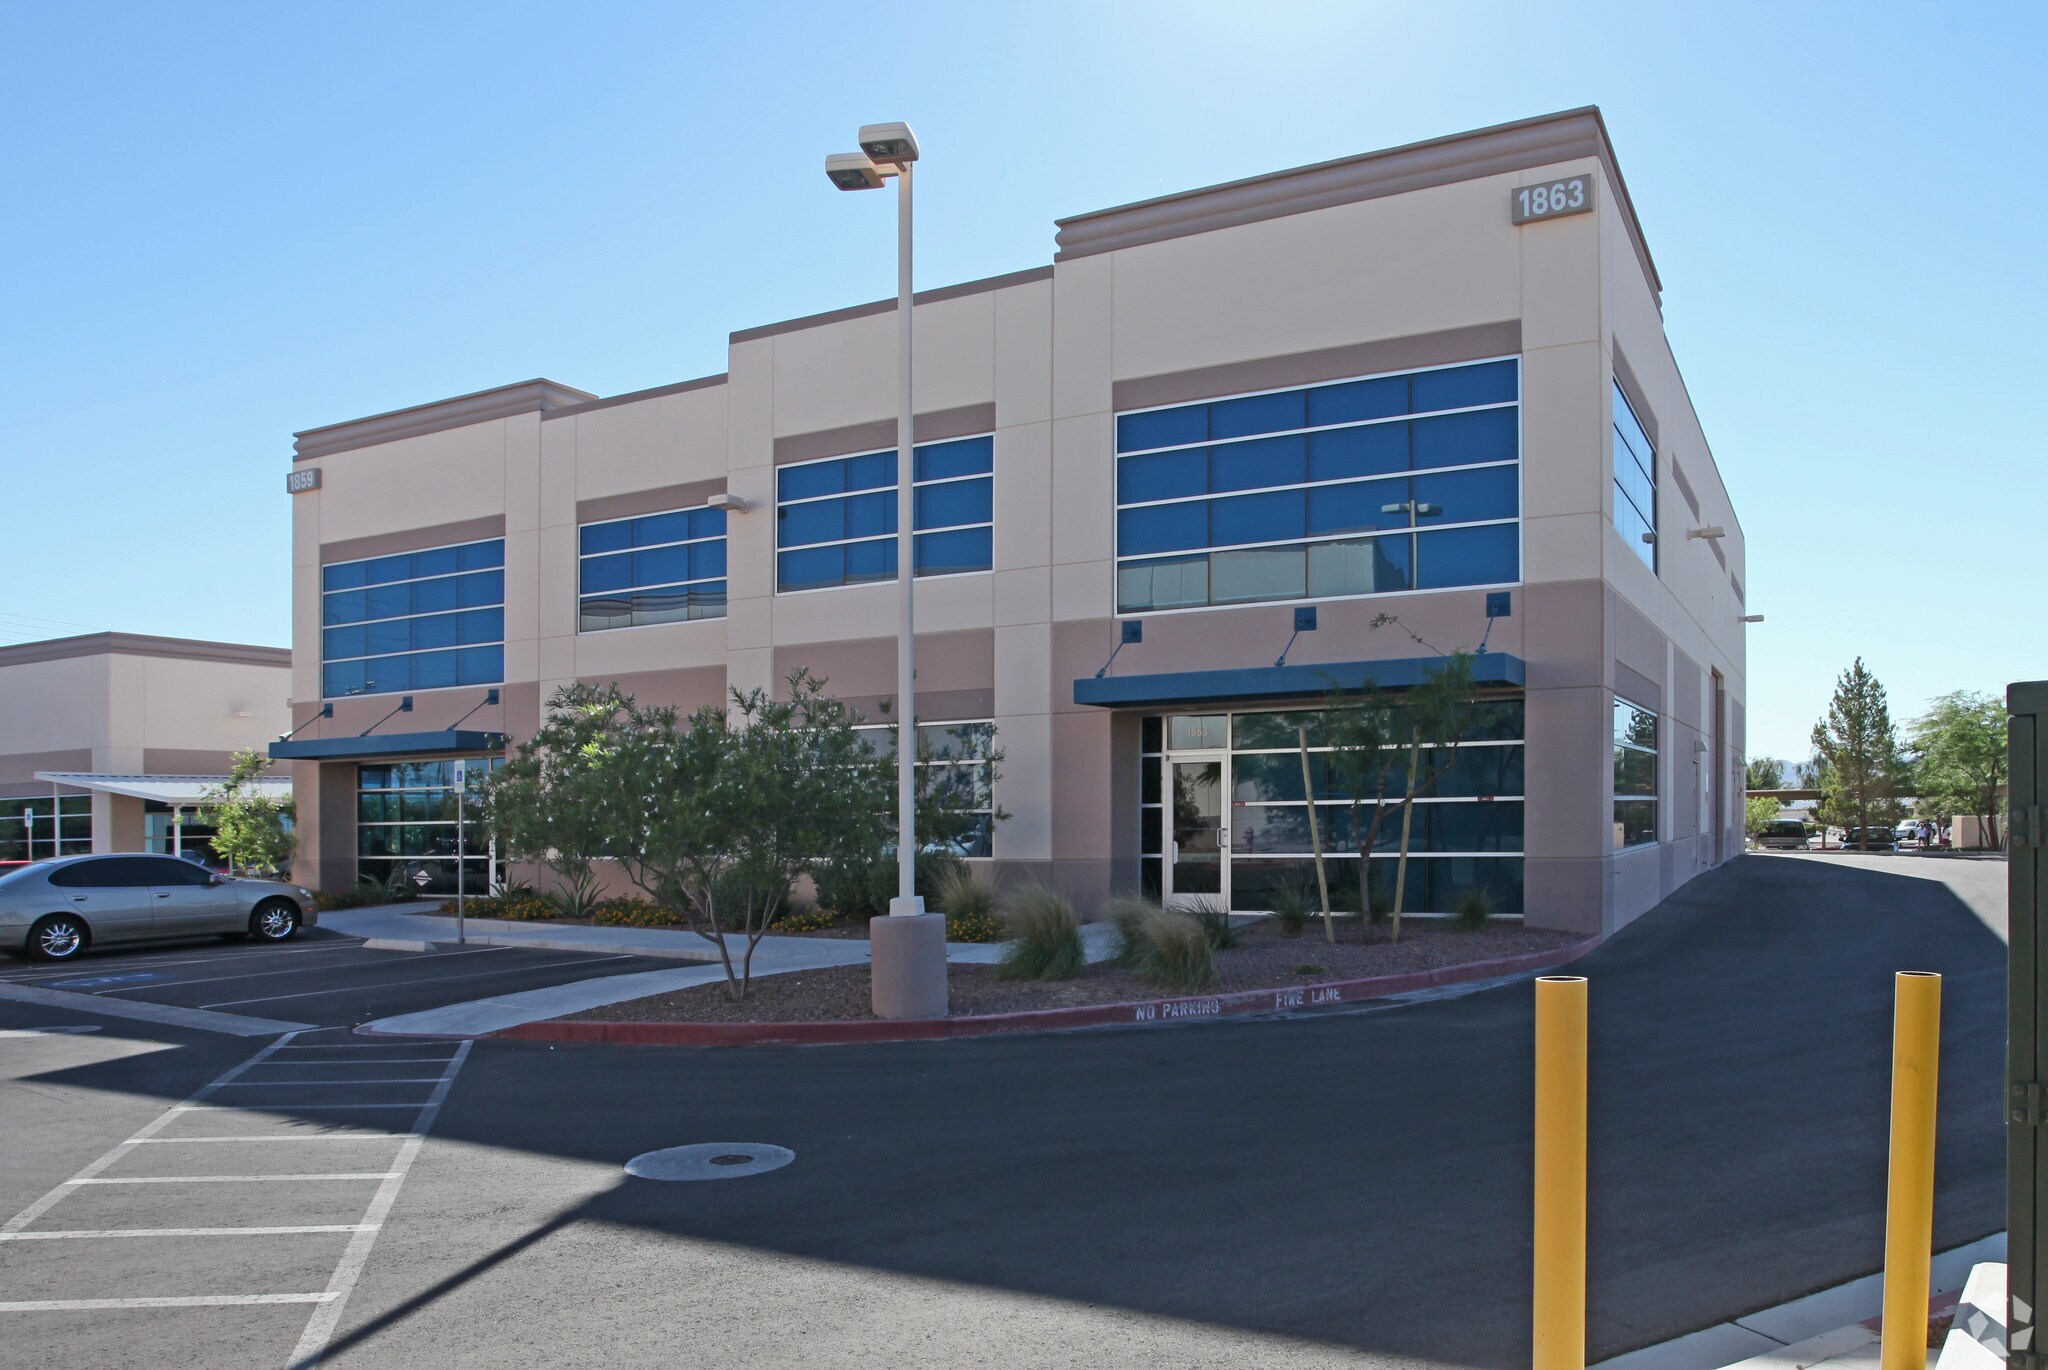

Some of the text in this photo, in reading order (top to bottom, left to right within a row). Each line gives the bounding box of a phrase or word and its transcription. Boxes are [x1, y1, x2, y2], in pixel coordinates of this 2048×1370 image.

[1519, 179, 1584, 217] 1863
[289, 471, 314, 491] 1859
[1136, 987, 1341, 1021] NO PARKING FIRE LANE
